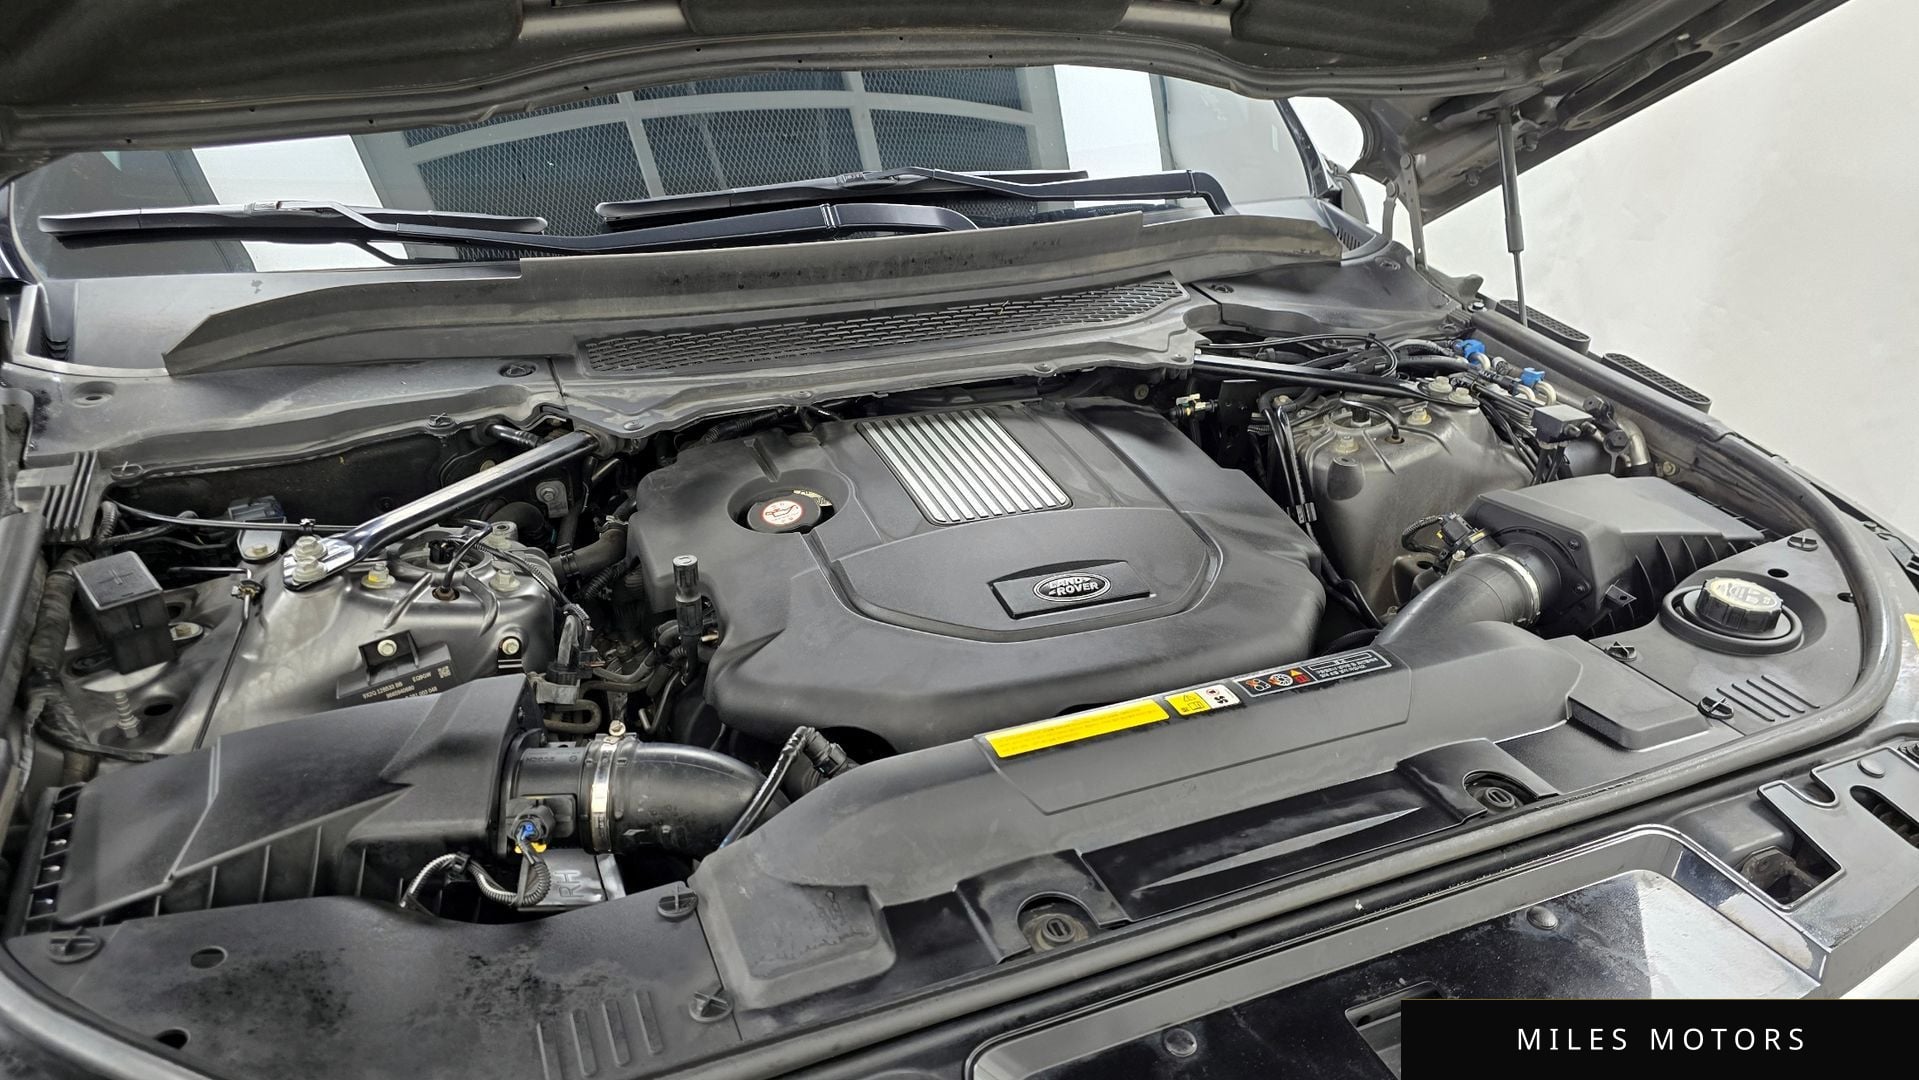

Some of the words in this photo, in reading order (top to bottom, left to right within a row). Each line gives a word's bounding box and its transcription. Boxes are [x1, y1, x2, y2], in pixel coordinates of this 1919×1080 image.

[1049, 576, 1083, 589] LAND
[1056, 581, 1099, 596] ROVER
[553, 870, 584, 898] RH
